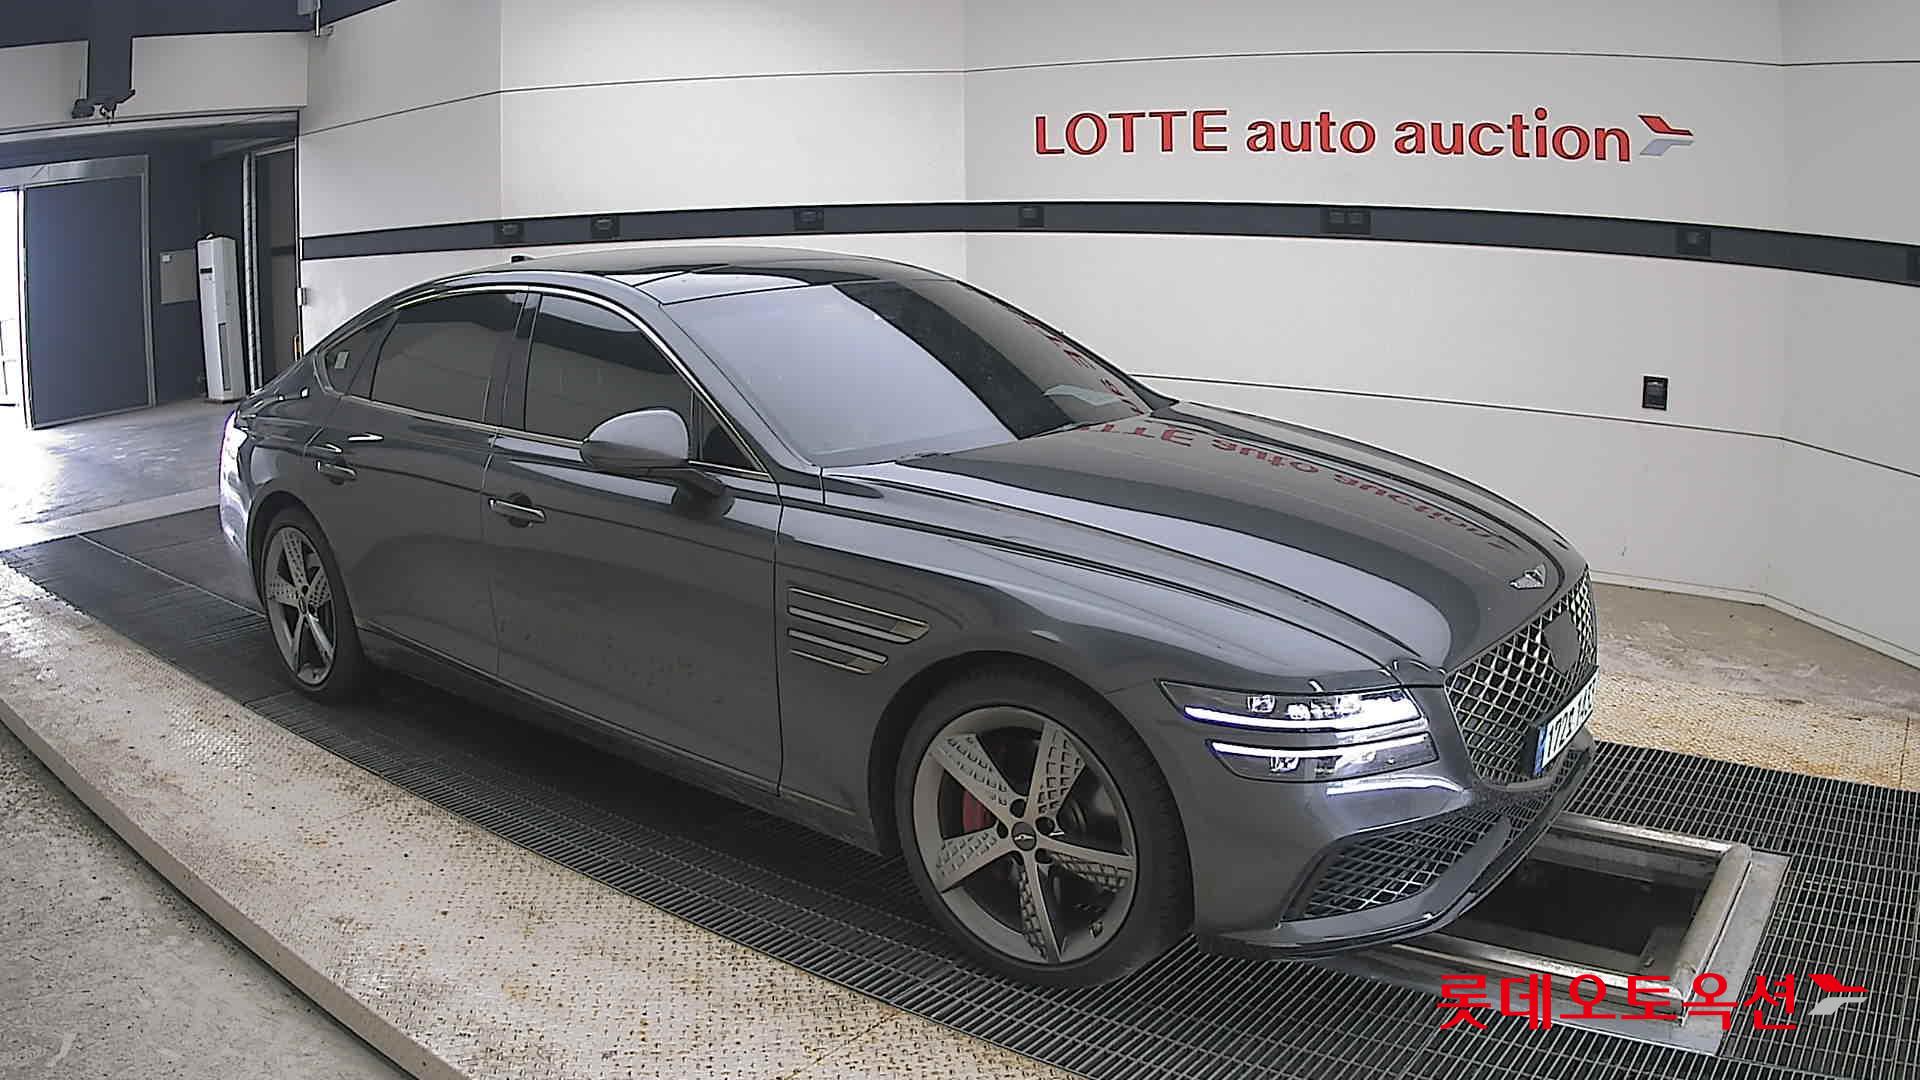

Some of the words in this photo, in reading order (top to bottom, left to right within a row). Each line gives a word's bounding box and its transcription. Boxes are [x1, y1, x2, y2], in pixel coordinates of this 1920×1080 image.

[1034, 110, 1228, 156] LOTTE
[1246, 111, 1376, 155] auto
[1393, 107, 1632, 162] auction
